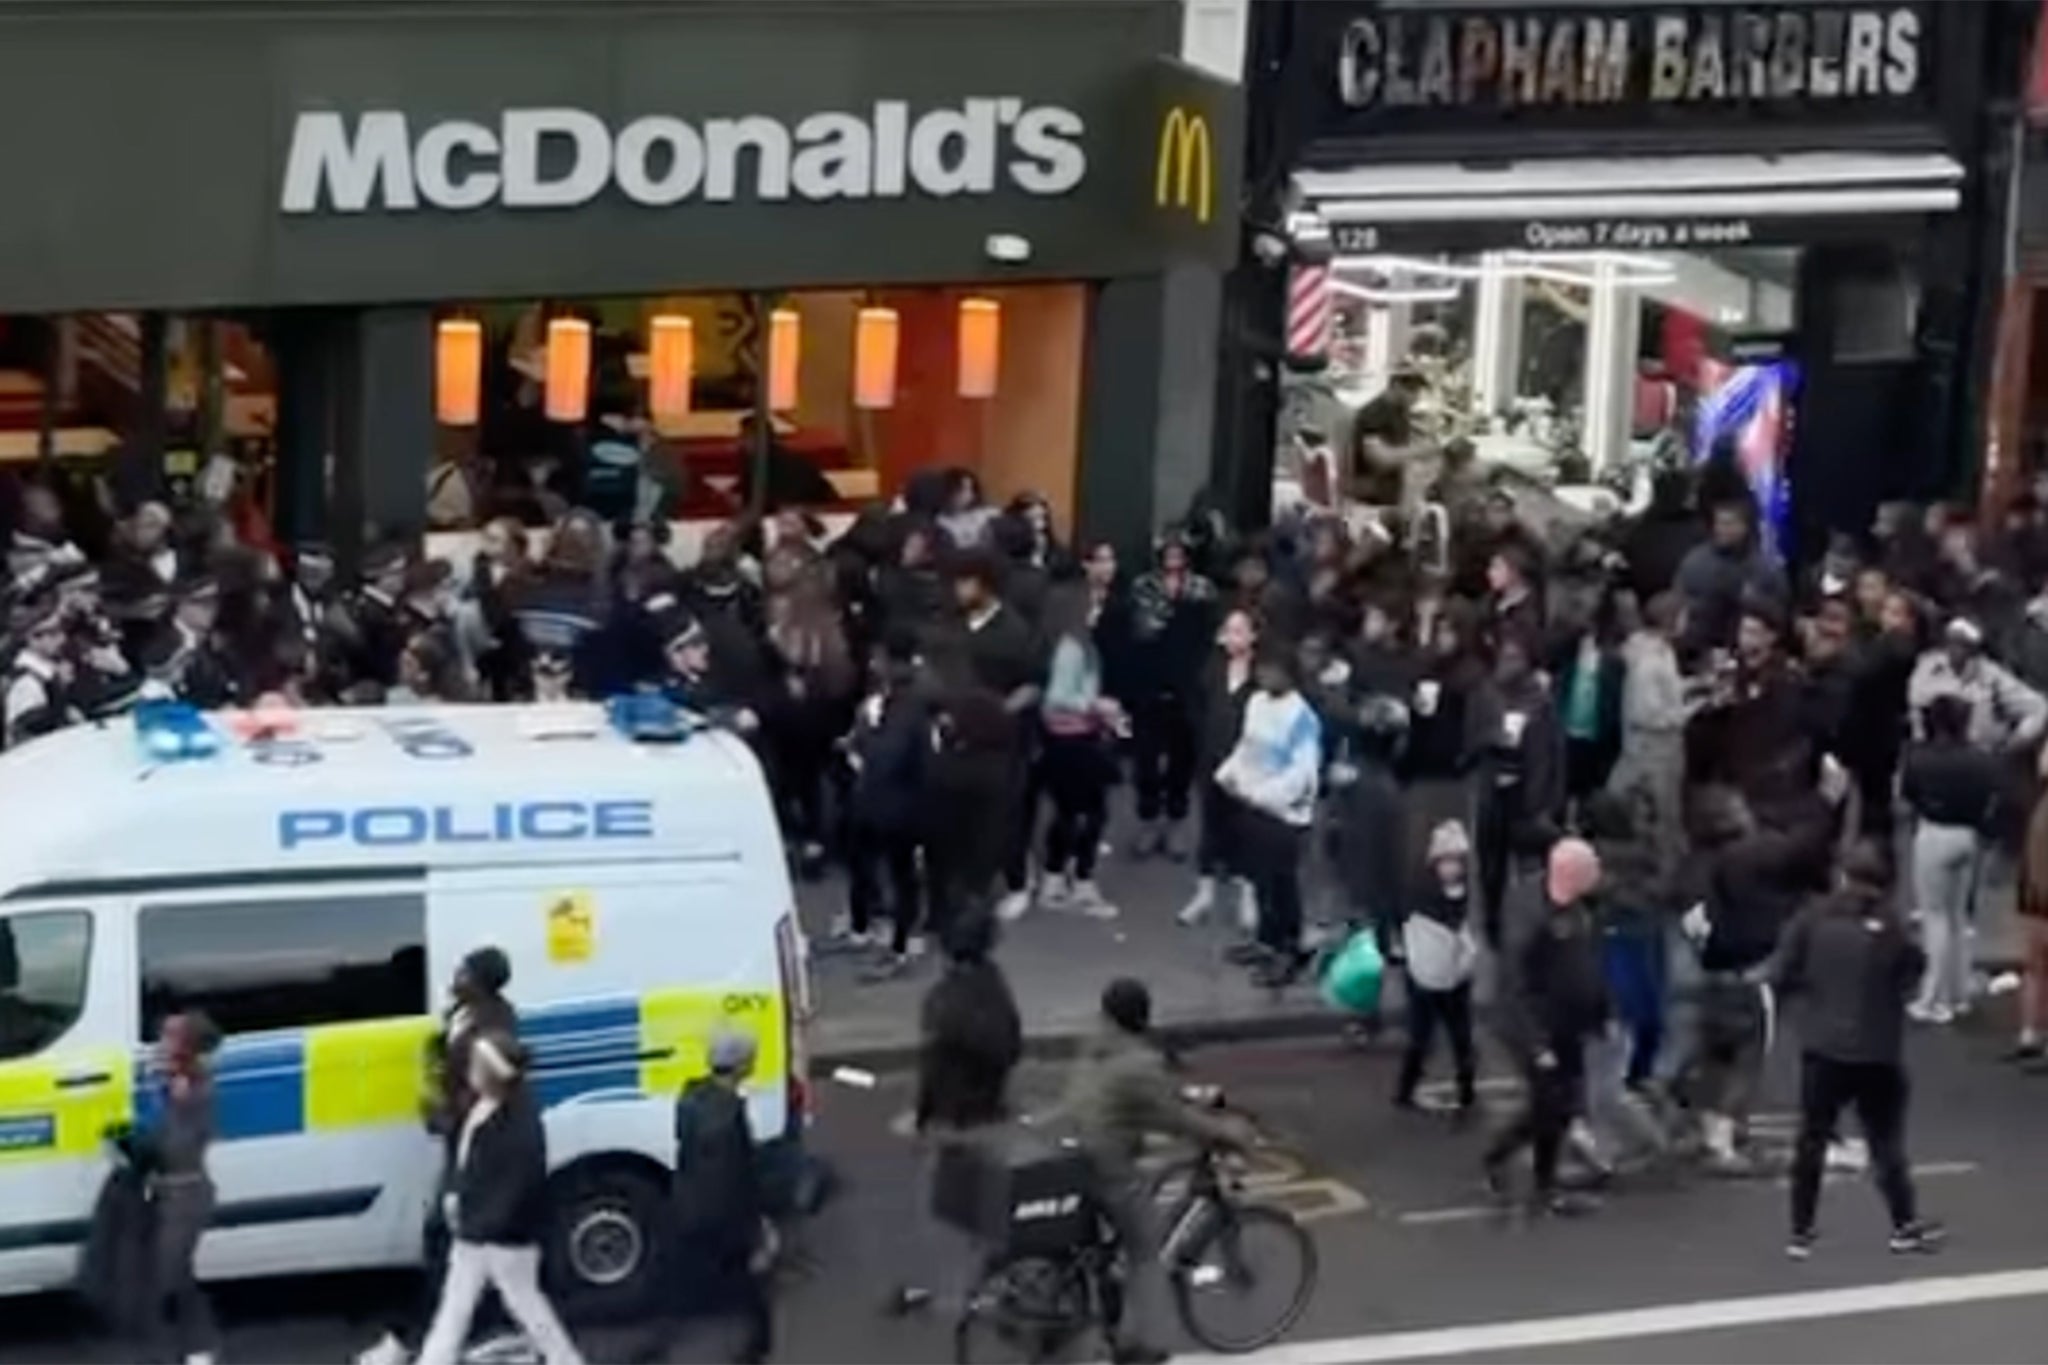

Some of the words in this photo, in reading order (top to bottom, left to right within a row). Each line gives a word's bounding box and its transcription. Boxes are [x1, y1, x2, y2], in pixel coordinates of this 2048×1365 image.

[1339, 16, 1629, 107] CLAPHAM
[1650, 9, 1920, 97] BARBERS
[281, 97, 1087, 212] McDonald's
[1336, 227, 1379, 250] 128
[1525, 222, 1590, 247] Open
[1595, 222, 1609, 243] 7
[1612, 221, 1668, 246] days
[1692, 219, 1751, 242] week
[279, 800, 654, 851] POLICE
